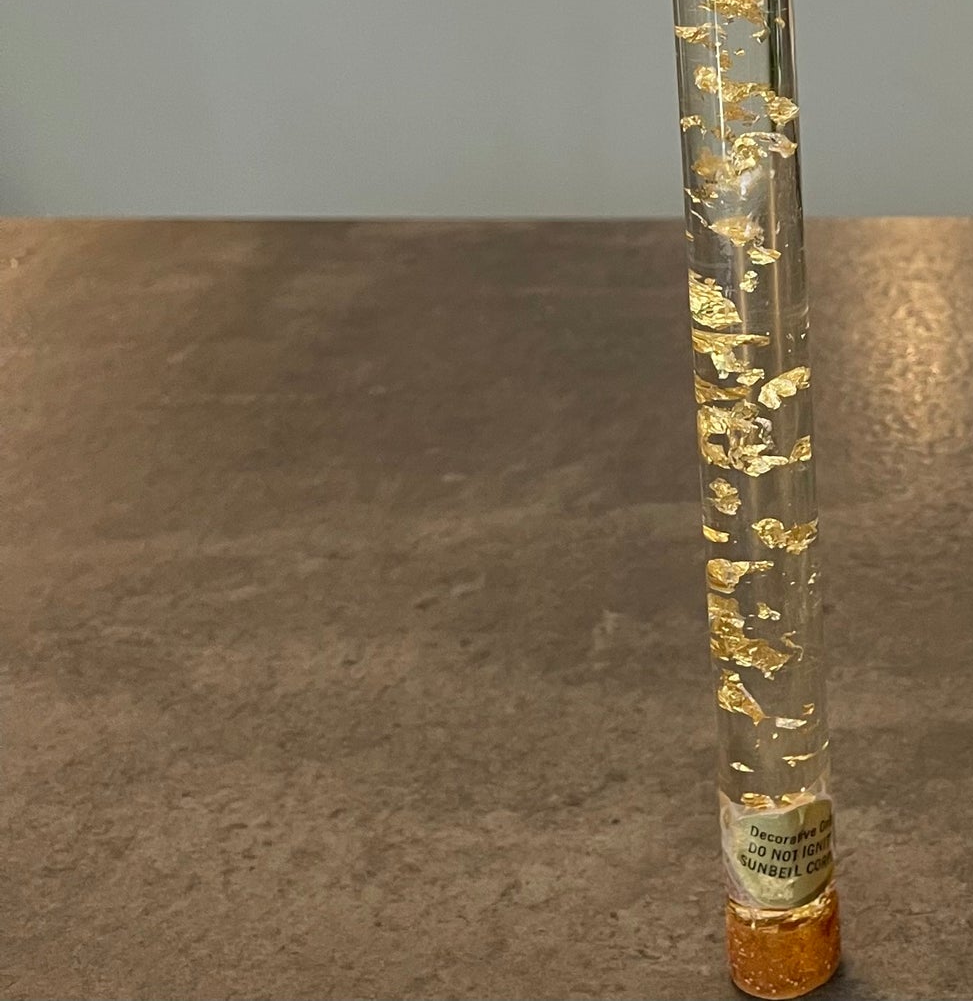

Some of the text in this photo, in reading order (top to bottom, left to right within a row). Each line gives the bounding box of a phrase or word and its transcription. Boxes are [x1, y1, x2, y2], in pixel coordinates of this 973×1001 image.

[748, 842, 766, 857] DO
[771, 848, 798, 863] NOT
[740, 854, 803, 879] SUNBELL
